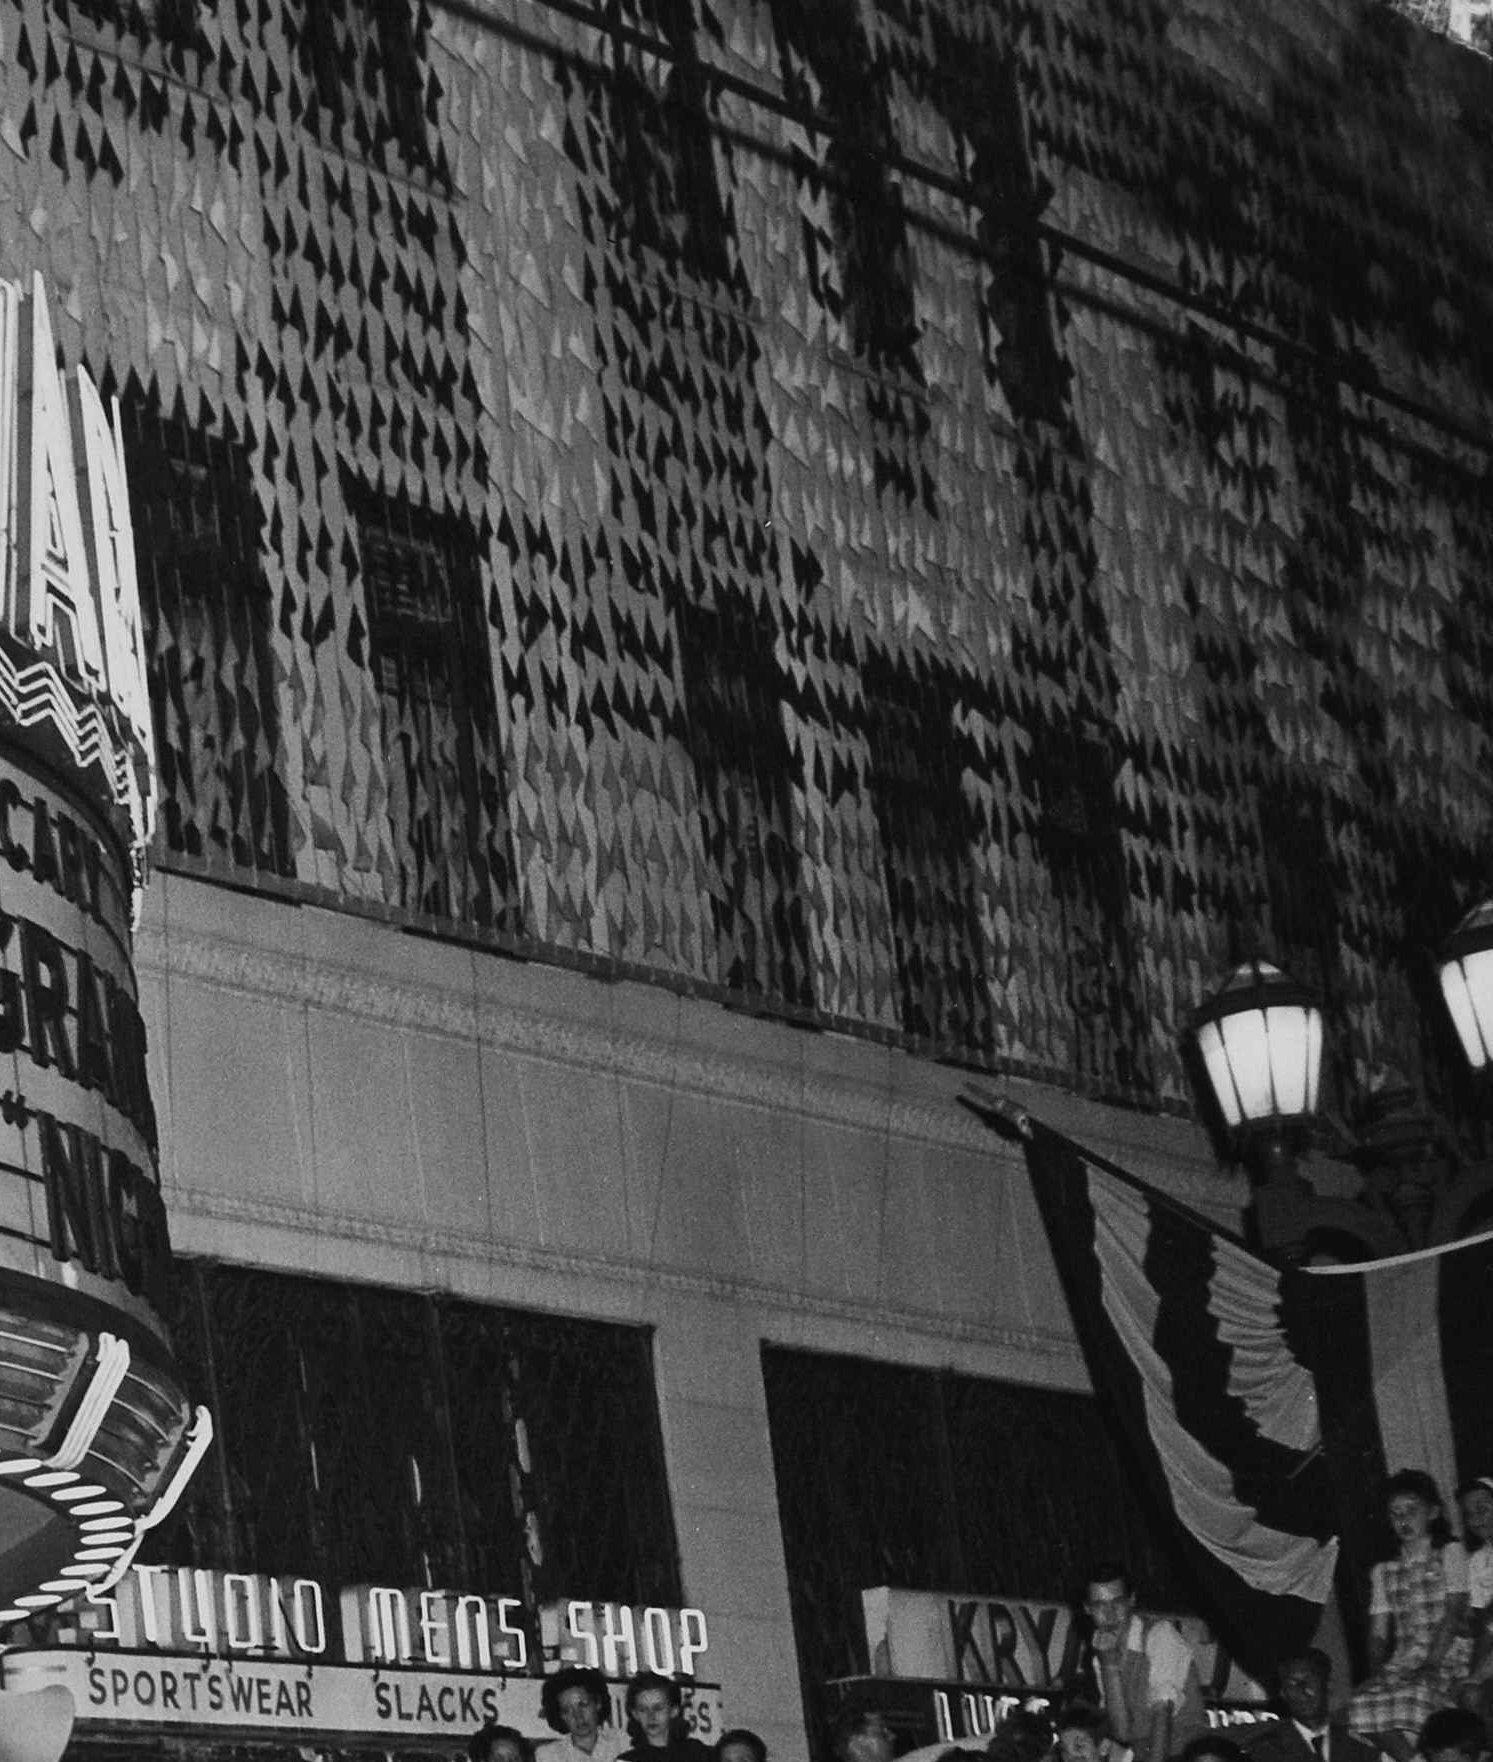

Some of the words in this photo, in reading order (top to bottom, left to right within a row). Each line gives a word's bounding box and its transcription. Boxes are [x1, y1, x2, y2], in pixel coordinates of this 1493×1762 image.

[85, 1564, 328, 1655] STUDIO
[566, 1600, 709, 1676] SHOP
[88, 1666, 315, 1718] SPORTSWEAR
[374, 1681, 501, 1727] SLACKS
